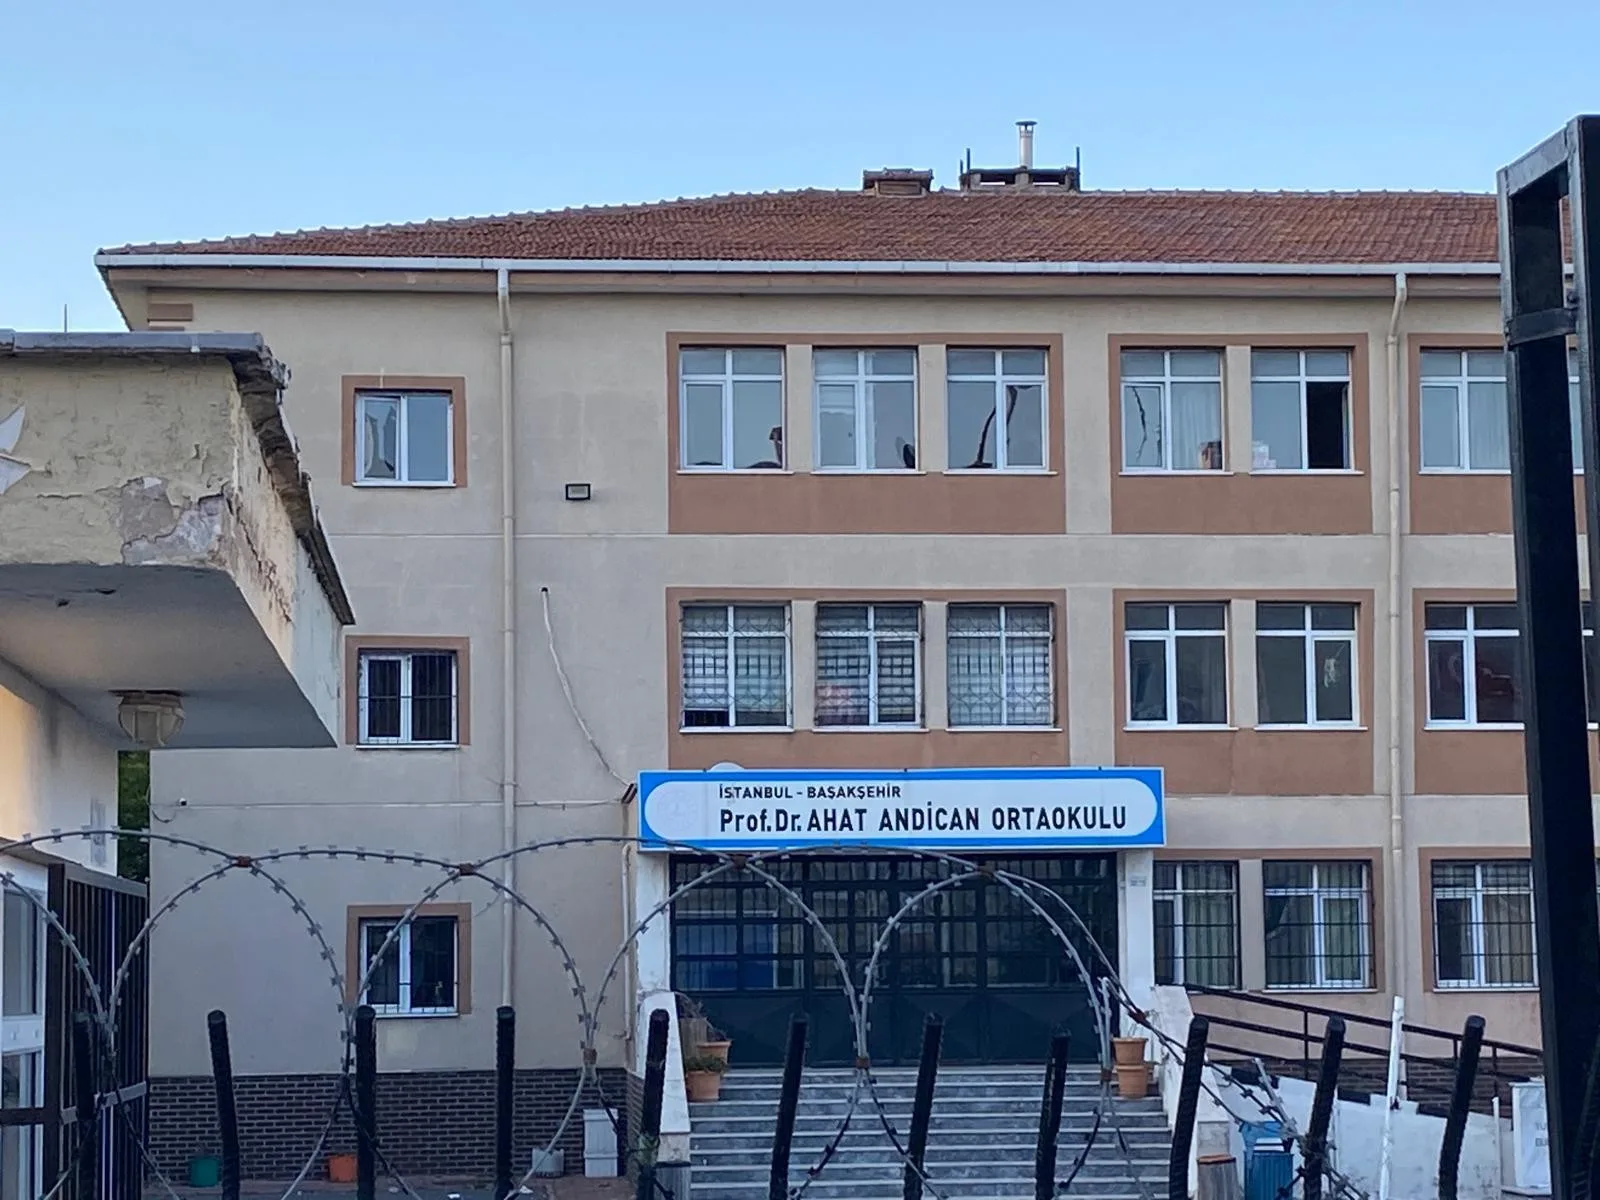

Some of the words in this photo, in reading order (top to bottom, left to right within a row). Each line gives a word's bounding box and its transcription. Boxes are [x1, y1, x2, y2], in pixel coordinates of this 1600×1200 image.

[719, 783, 793, 799] İSTANBUL
[807, 783, 902, 800] BAŞAKŞEHİR
[878, 801, 980, 832] ANDİCAN
[991, 806, 1126, 831] ORTAOKULU
